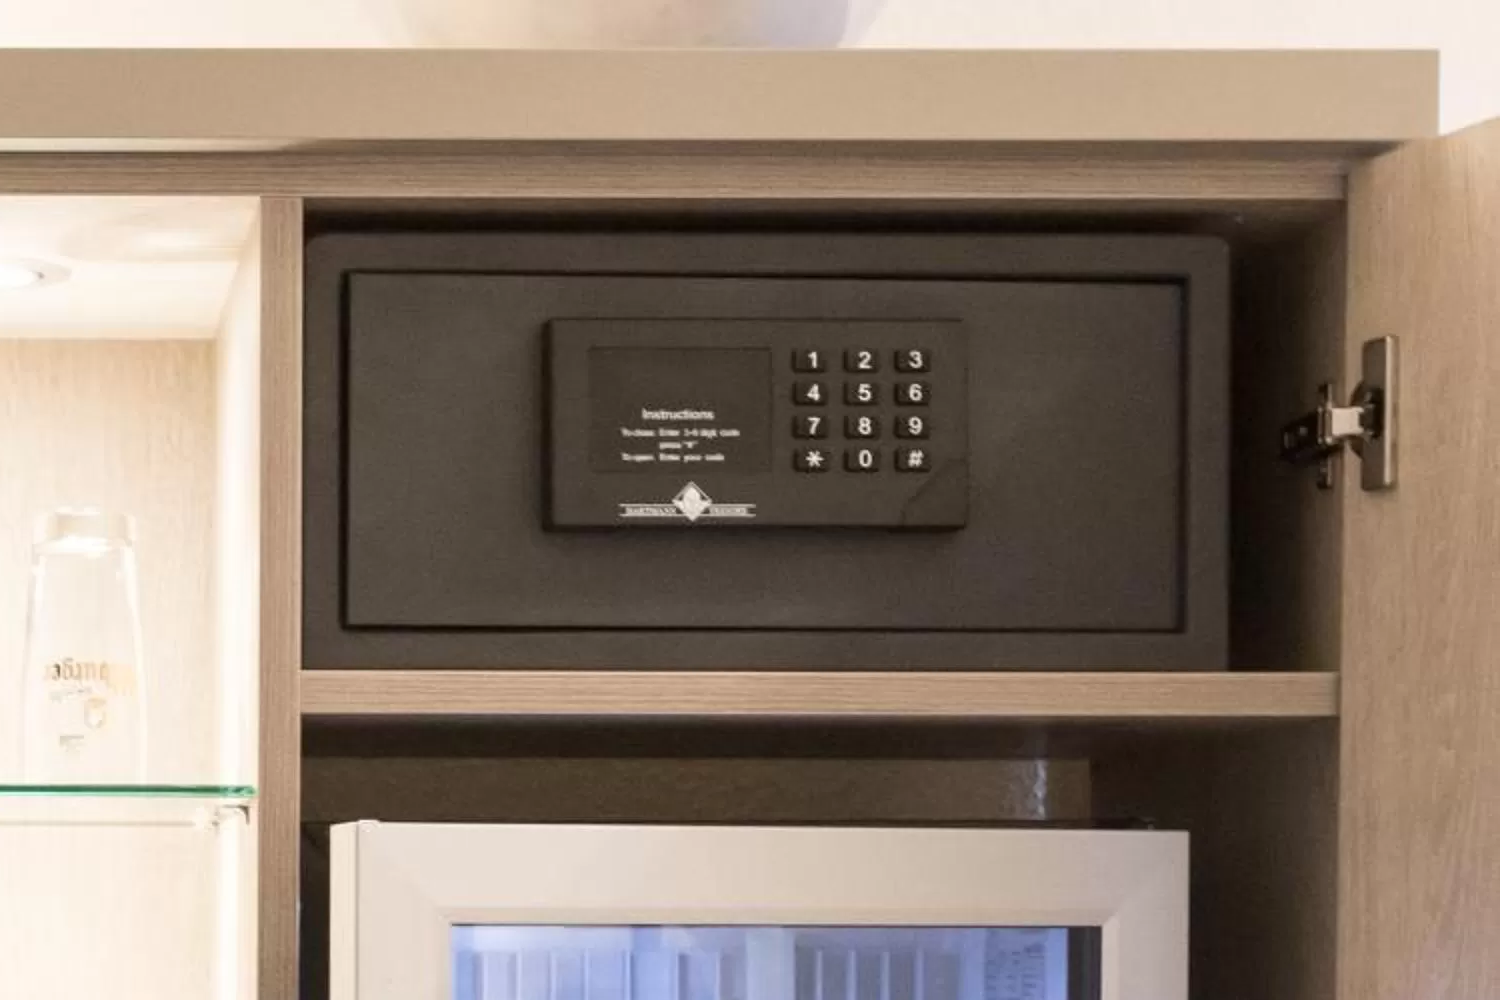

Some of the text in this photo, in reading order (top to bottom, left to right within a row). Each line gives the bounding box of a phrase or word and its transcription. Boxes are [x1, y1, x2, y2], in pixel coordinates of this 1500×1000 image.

[808, 350, 923, 370] 1 2 3
[806, 383, 923, 402] 4 5 6
[641, 408, 715, 421] Instructions
[807, 416, 923, 435] 7 8 9
[858, 449, 873, 468] 0
[908, 449, 925, 468] #
